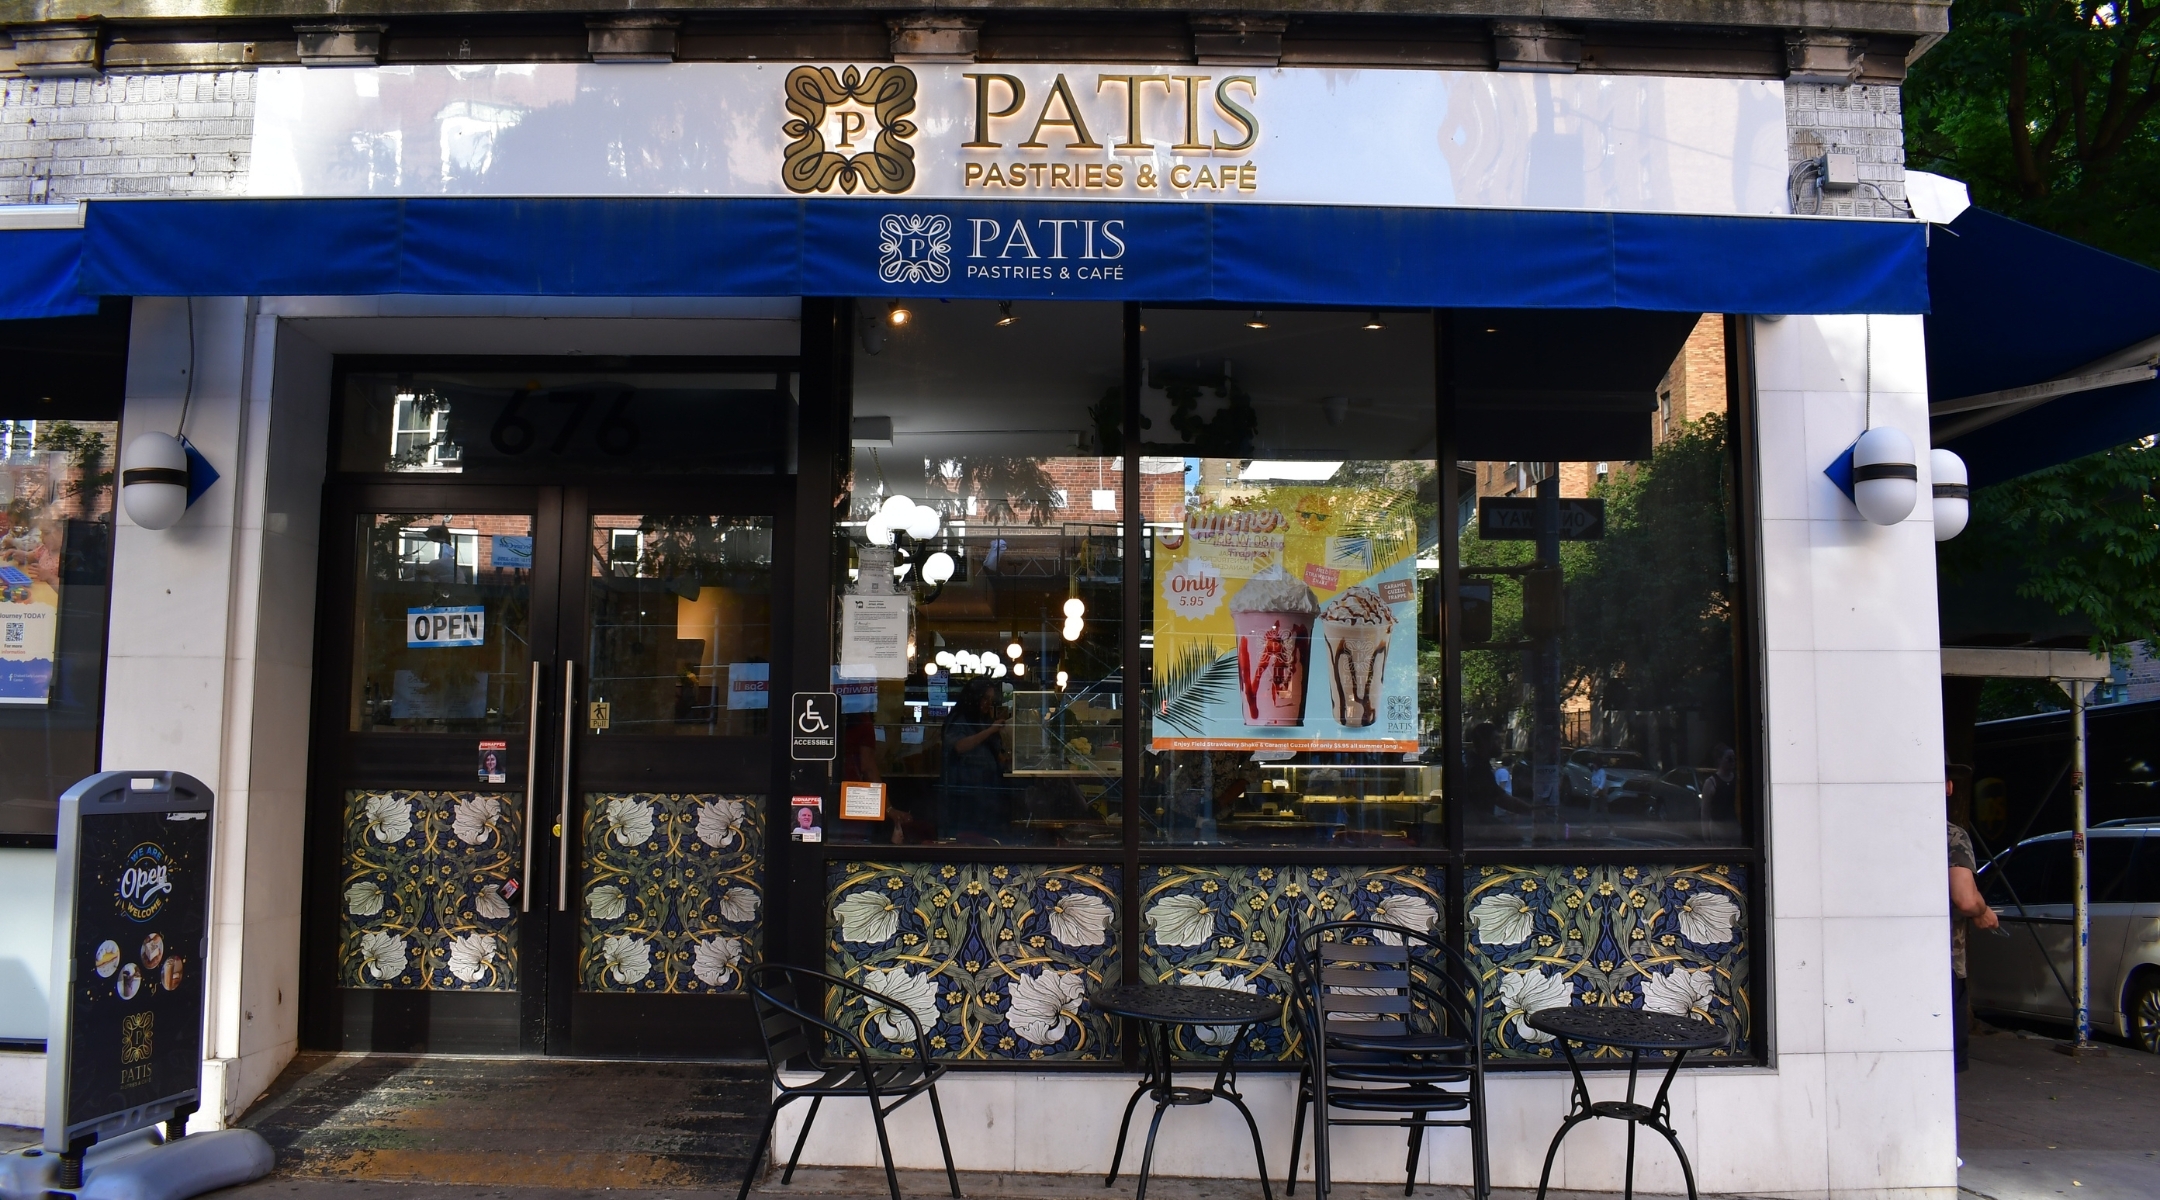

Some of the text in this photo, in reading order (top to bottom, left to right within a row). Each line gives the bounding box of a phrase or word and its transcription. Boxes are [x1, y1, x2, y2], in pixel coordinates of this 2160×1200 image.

[961, 73, 1260, 151] PATIS
[835, 111, 866, 149] P
[964, 160, 1258, 190] PASTRIES & CAFÉ
[910, 238, 925, 258] P
[967, 218, 1126, 260] PATIS
[967, 264, 1124, 280] PASTRIES & CAFÉ
[490, 389, 640, 456] 676
[1171, 571, 1219, 597] Only
[1179, 596, 1204, 606] 5.95
[414, 614, 479, 640] OPEN
[1388, 722, 1412, 730] PATIS
[130, 846, 163, 862] WE ARE
[121, 865, 172, 904] Open
[127, 898, 162, 918] WELCOME
[120, 1063, 152, 1084] PATIS
